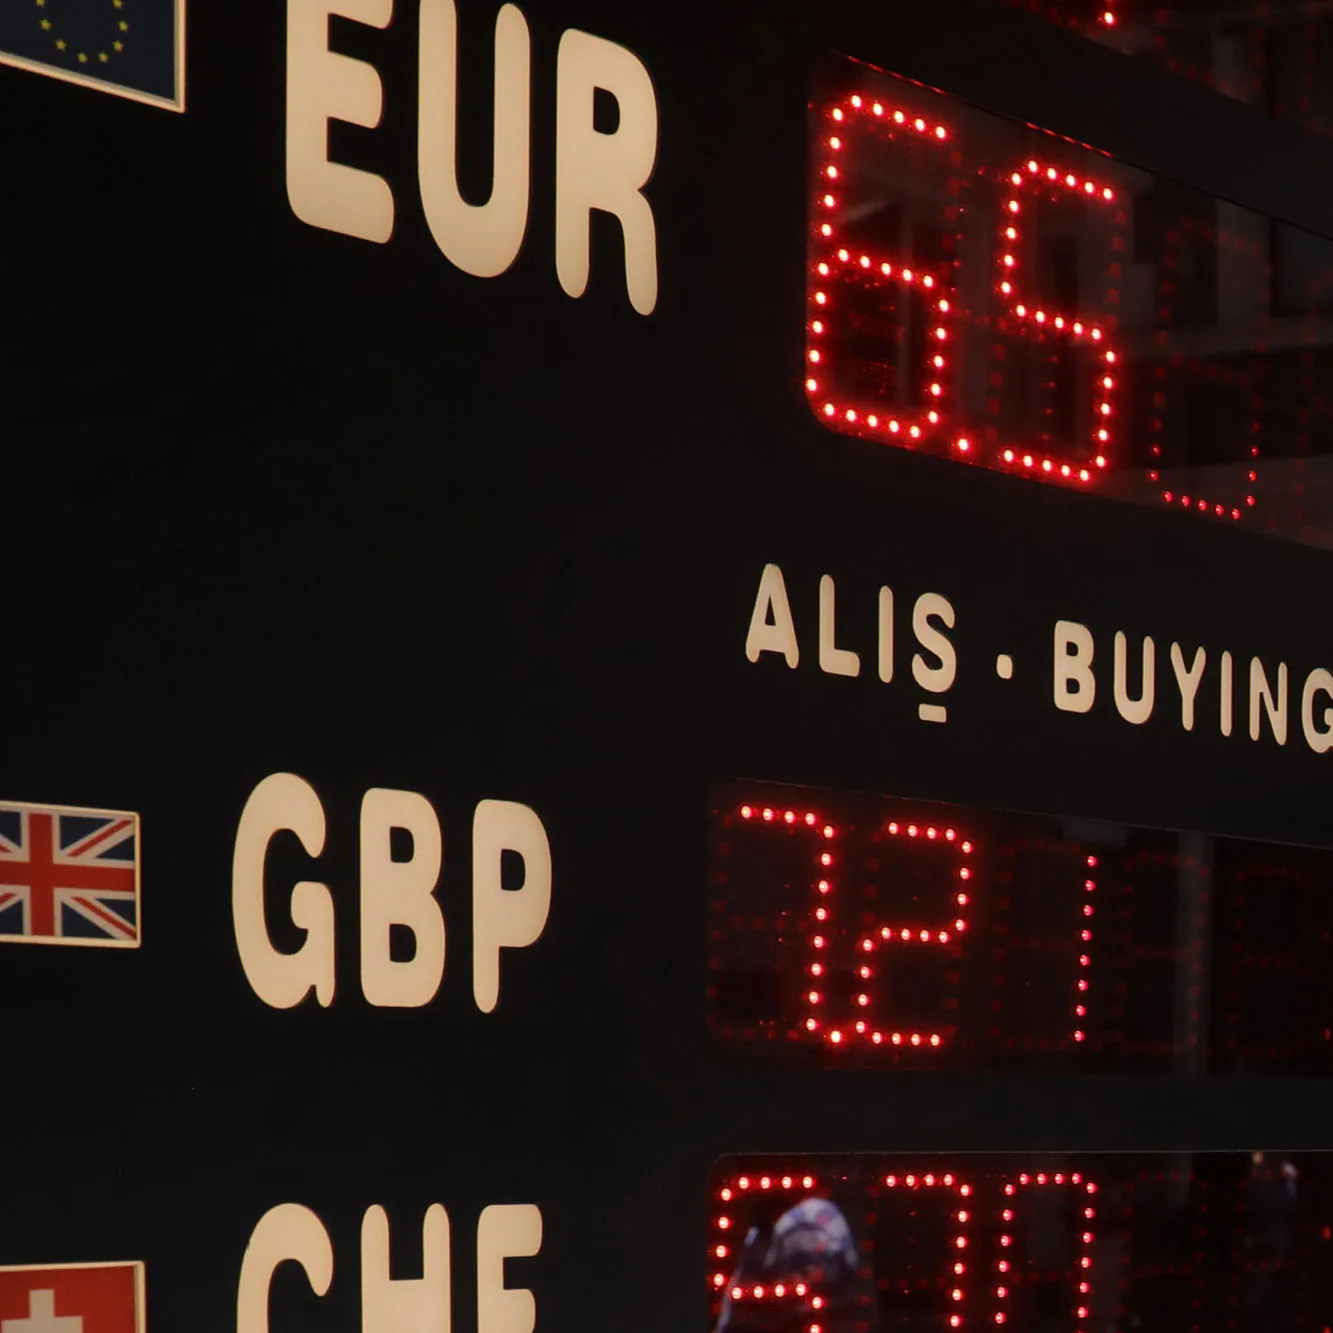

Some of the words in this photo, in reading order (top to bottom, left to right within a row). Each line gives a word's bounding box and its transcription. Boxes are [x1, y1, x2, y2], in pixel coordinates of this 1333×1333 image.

[285, 0, 658, 316] EUR
[745, 563, 957, 723] ALIŞ
[231, 772, 552, 1014] GBP
